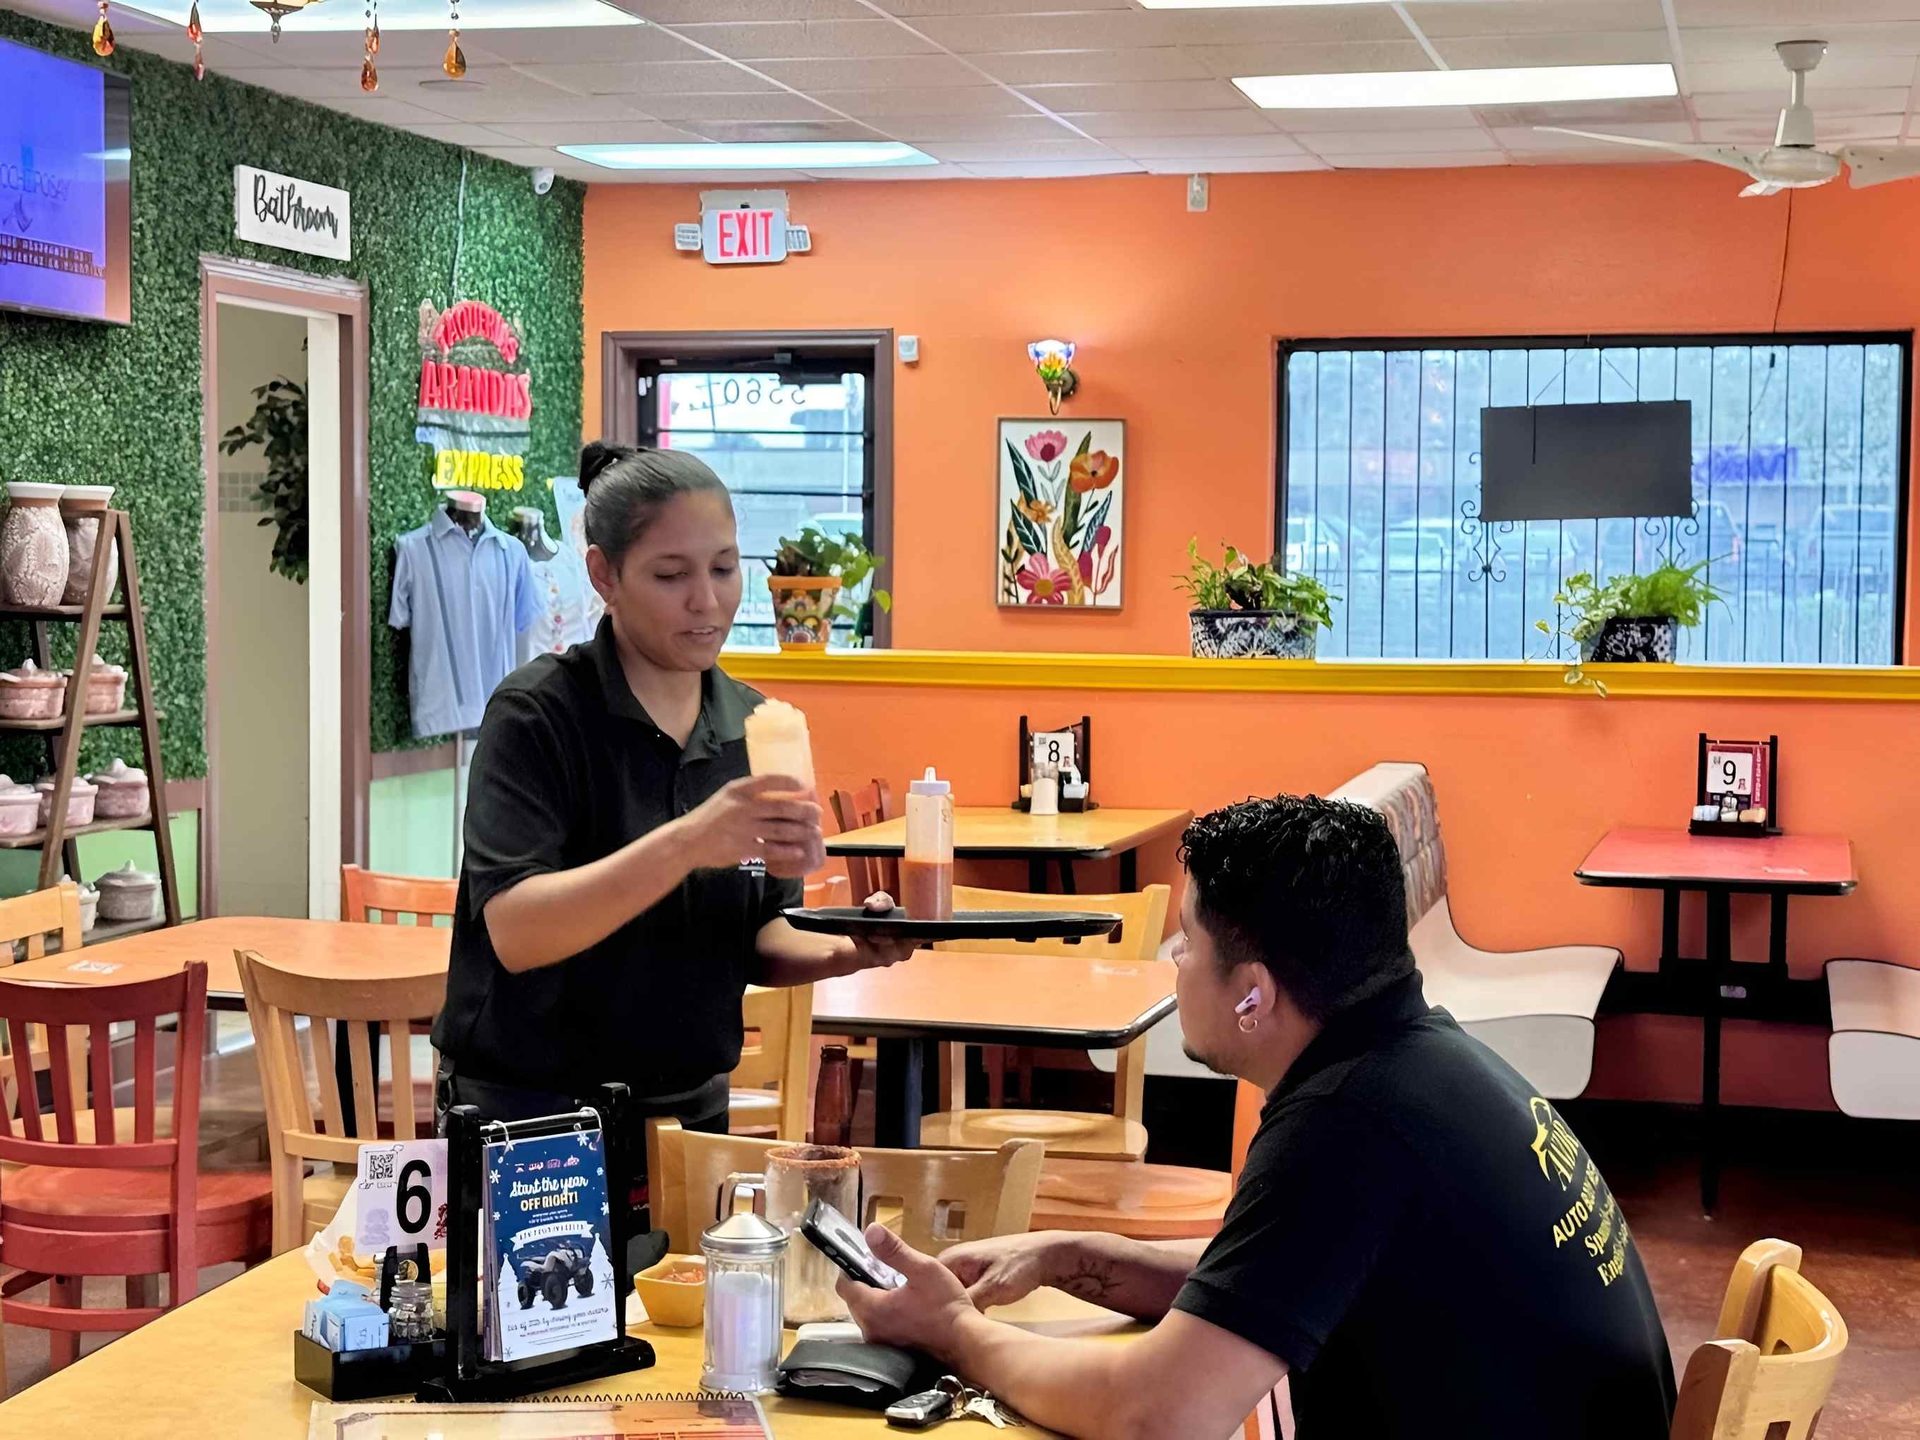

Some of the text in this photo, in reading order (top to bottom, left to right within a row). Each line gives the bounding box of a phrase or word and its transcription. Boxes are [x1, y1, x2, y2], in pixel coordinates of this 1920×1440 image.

[253, 173, 339, 240] Bathroom
[718, 211, 774, 258] EXIT
[420, 358, 533, 420] ARANDAS
[435, 449, 524, 492] EXPRESS
[1048, 740, 1060, 763] 8
[1723, 760, 1737, 785] 9
[396, 1159, 433, 1235] 6
[509, 1175, 589, 1198] Start the year
[520, 1197, 541, 1212] OFF
[1553, 1200, 1589, 1249] AUTO
